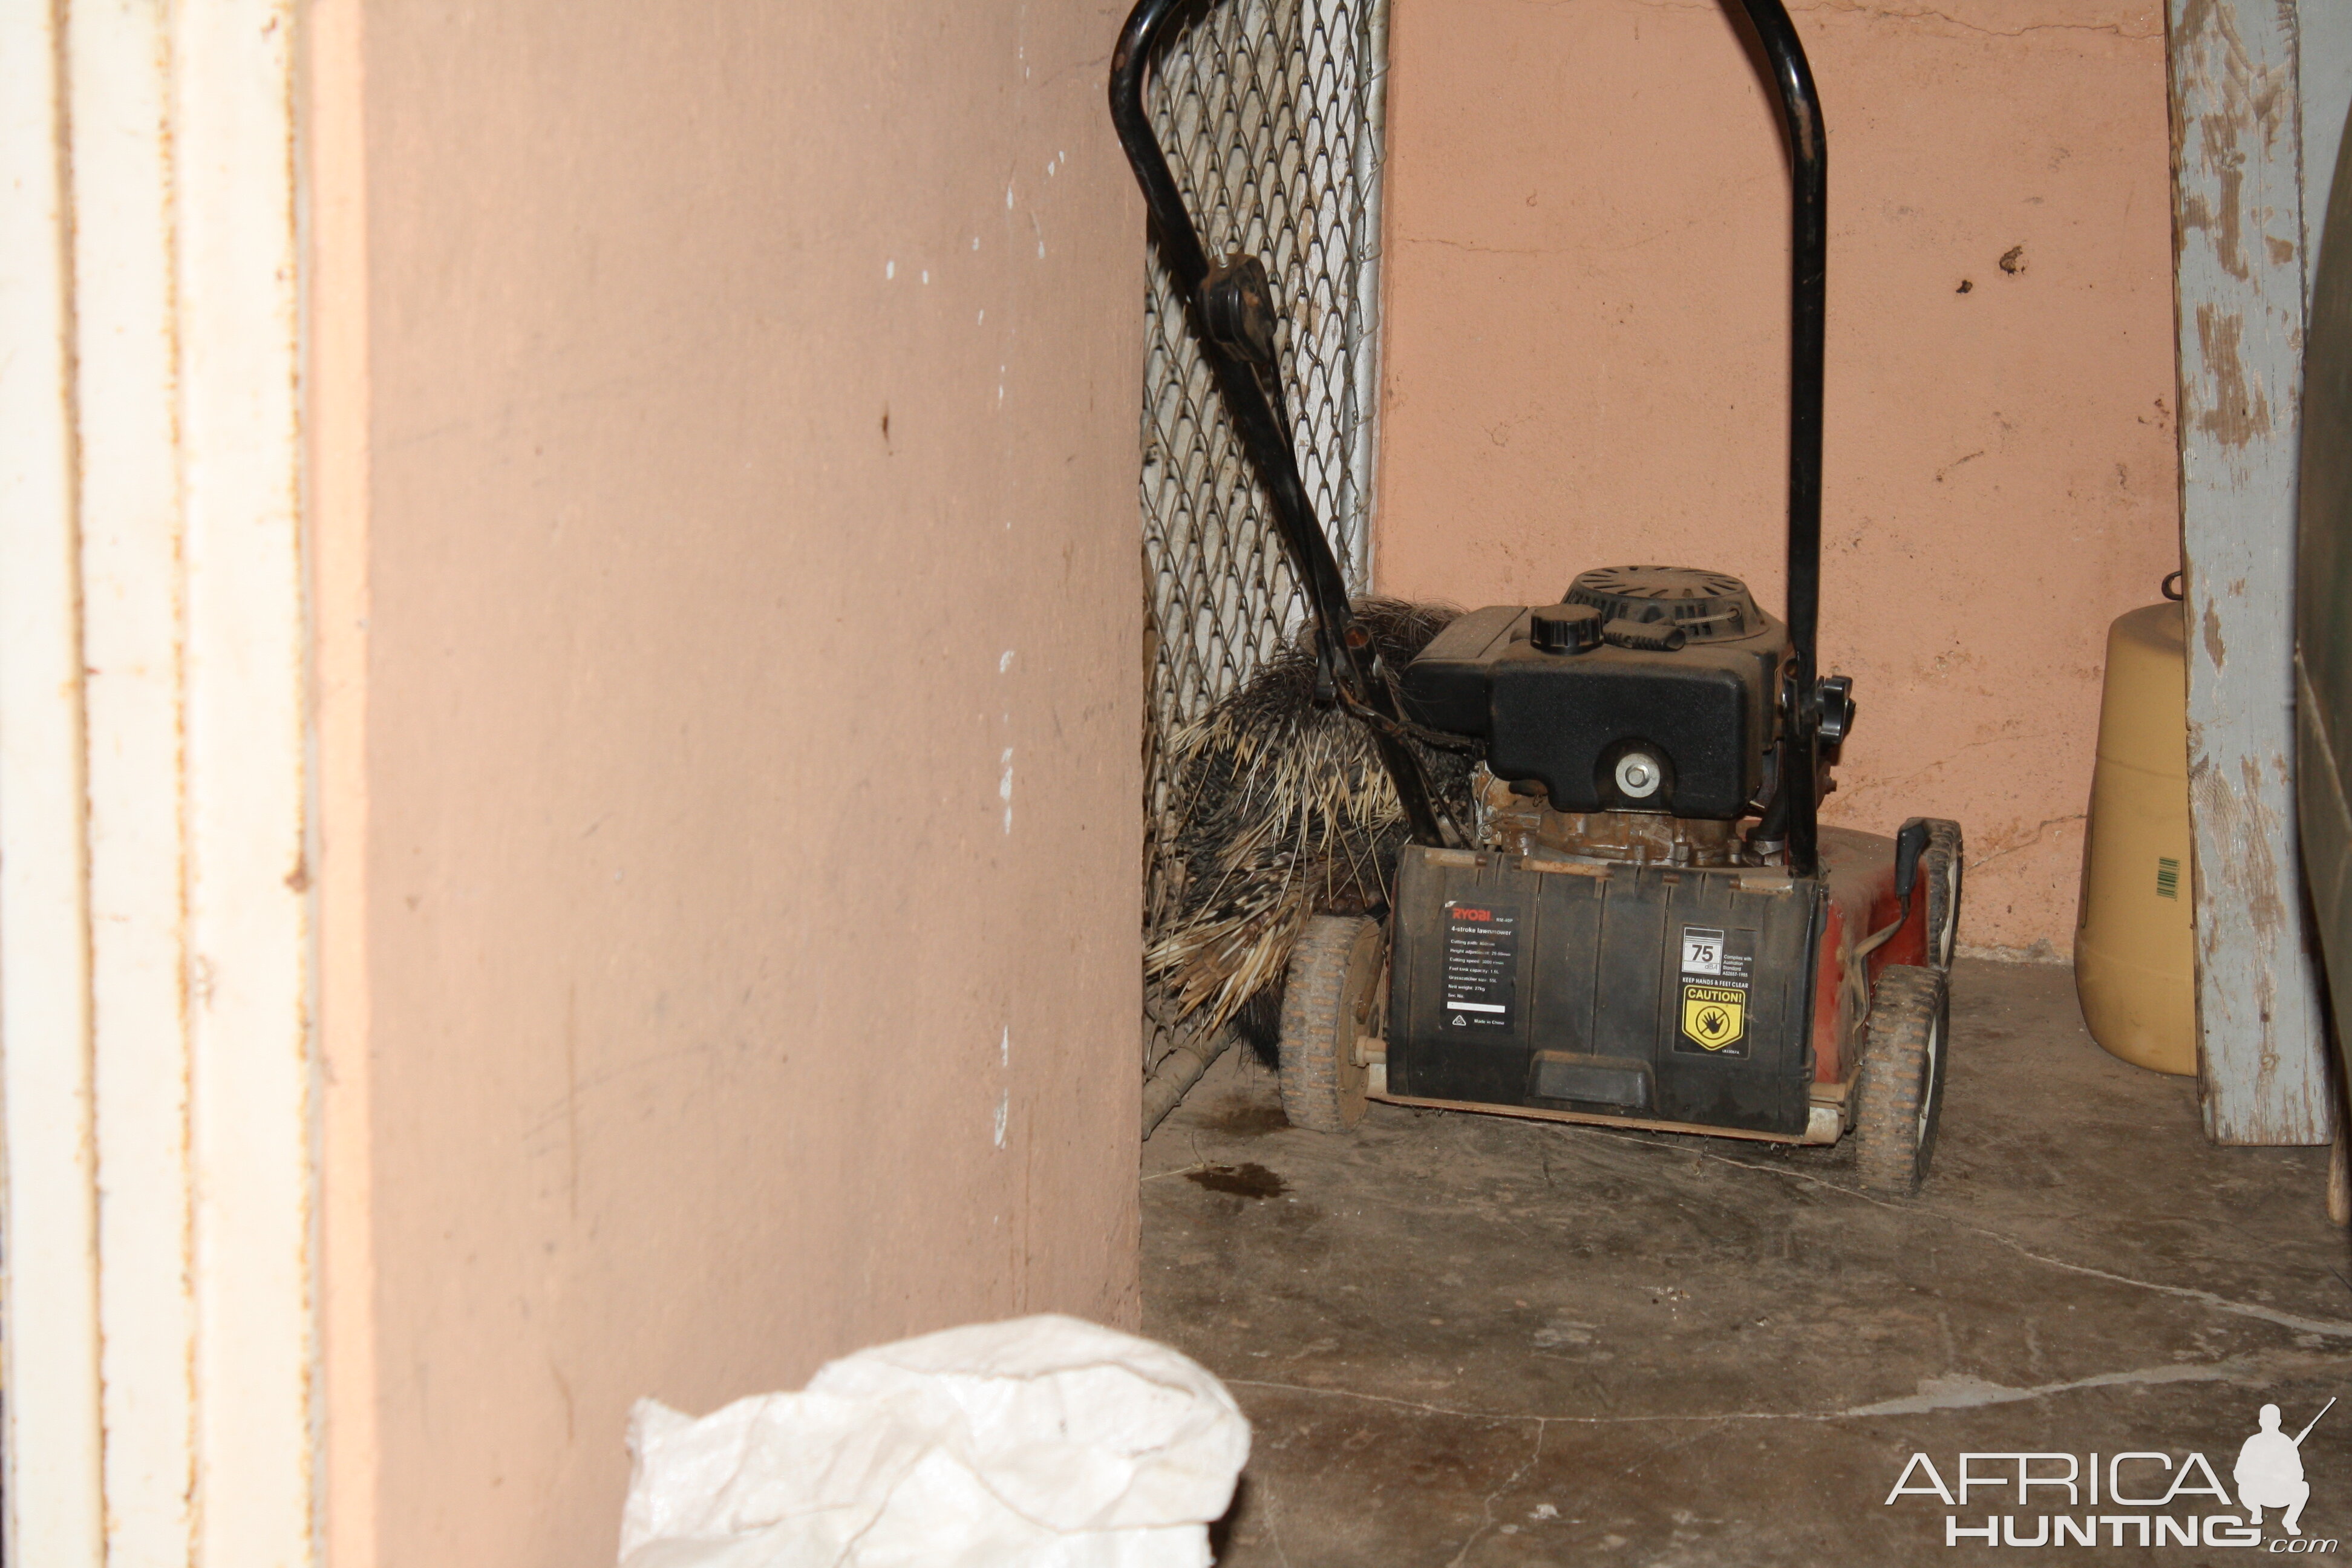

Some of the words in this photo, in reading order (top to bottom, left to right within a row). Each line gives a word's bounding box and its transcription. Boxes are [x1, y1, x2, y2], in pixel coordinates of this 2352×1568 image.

[1453, 907, 1491, 921] RYOBI
[1692, 944, 1713, 962] 75
[1688, 988, 1742, 1003] CAUTION!
